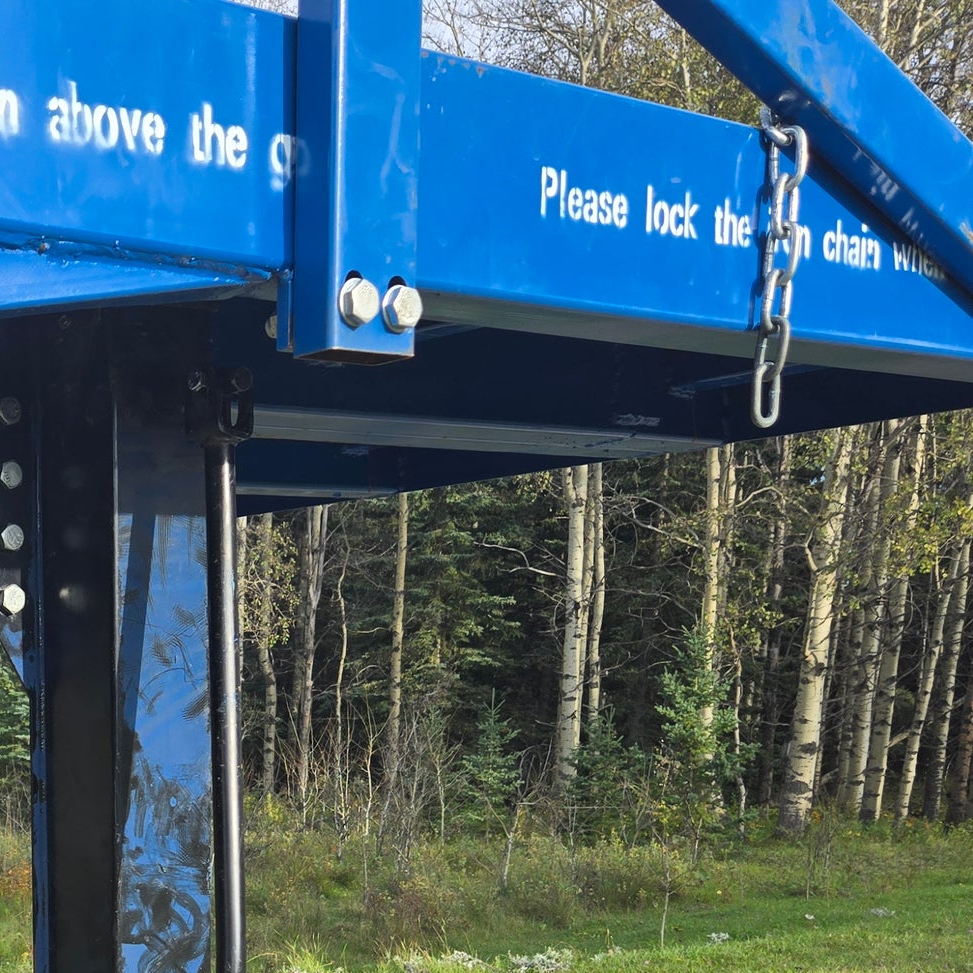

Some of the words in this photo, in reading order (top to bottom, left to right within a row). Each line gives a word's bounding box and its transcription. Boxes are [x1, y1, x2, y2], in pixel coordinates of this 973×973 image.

[48, 80, 166, 155] above
[189, 102, 249, 169] the
[540, 166, 629, 229] Please
[646, 184, 699, 239] lock
[715, 198, 752, 248] the
[823, 219, 881, 270] chain
